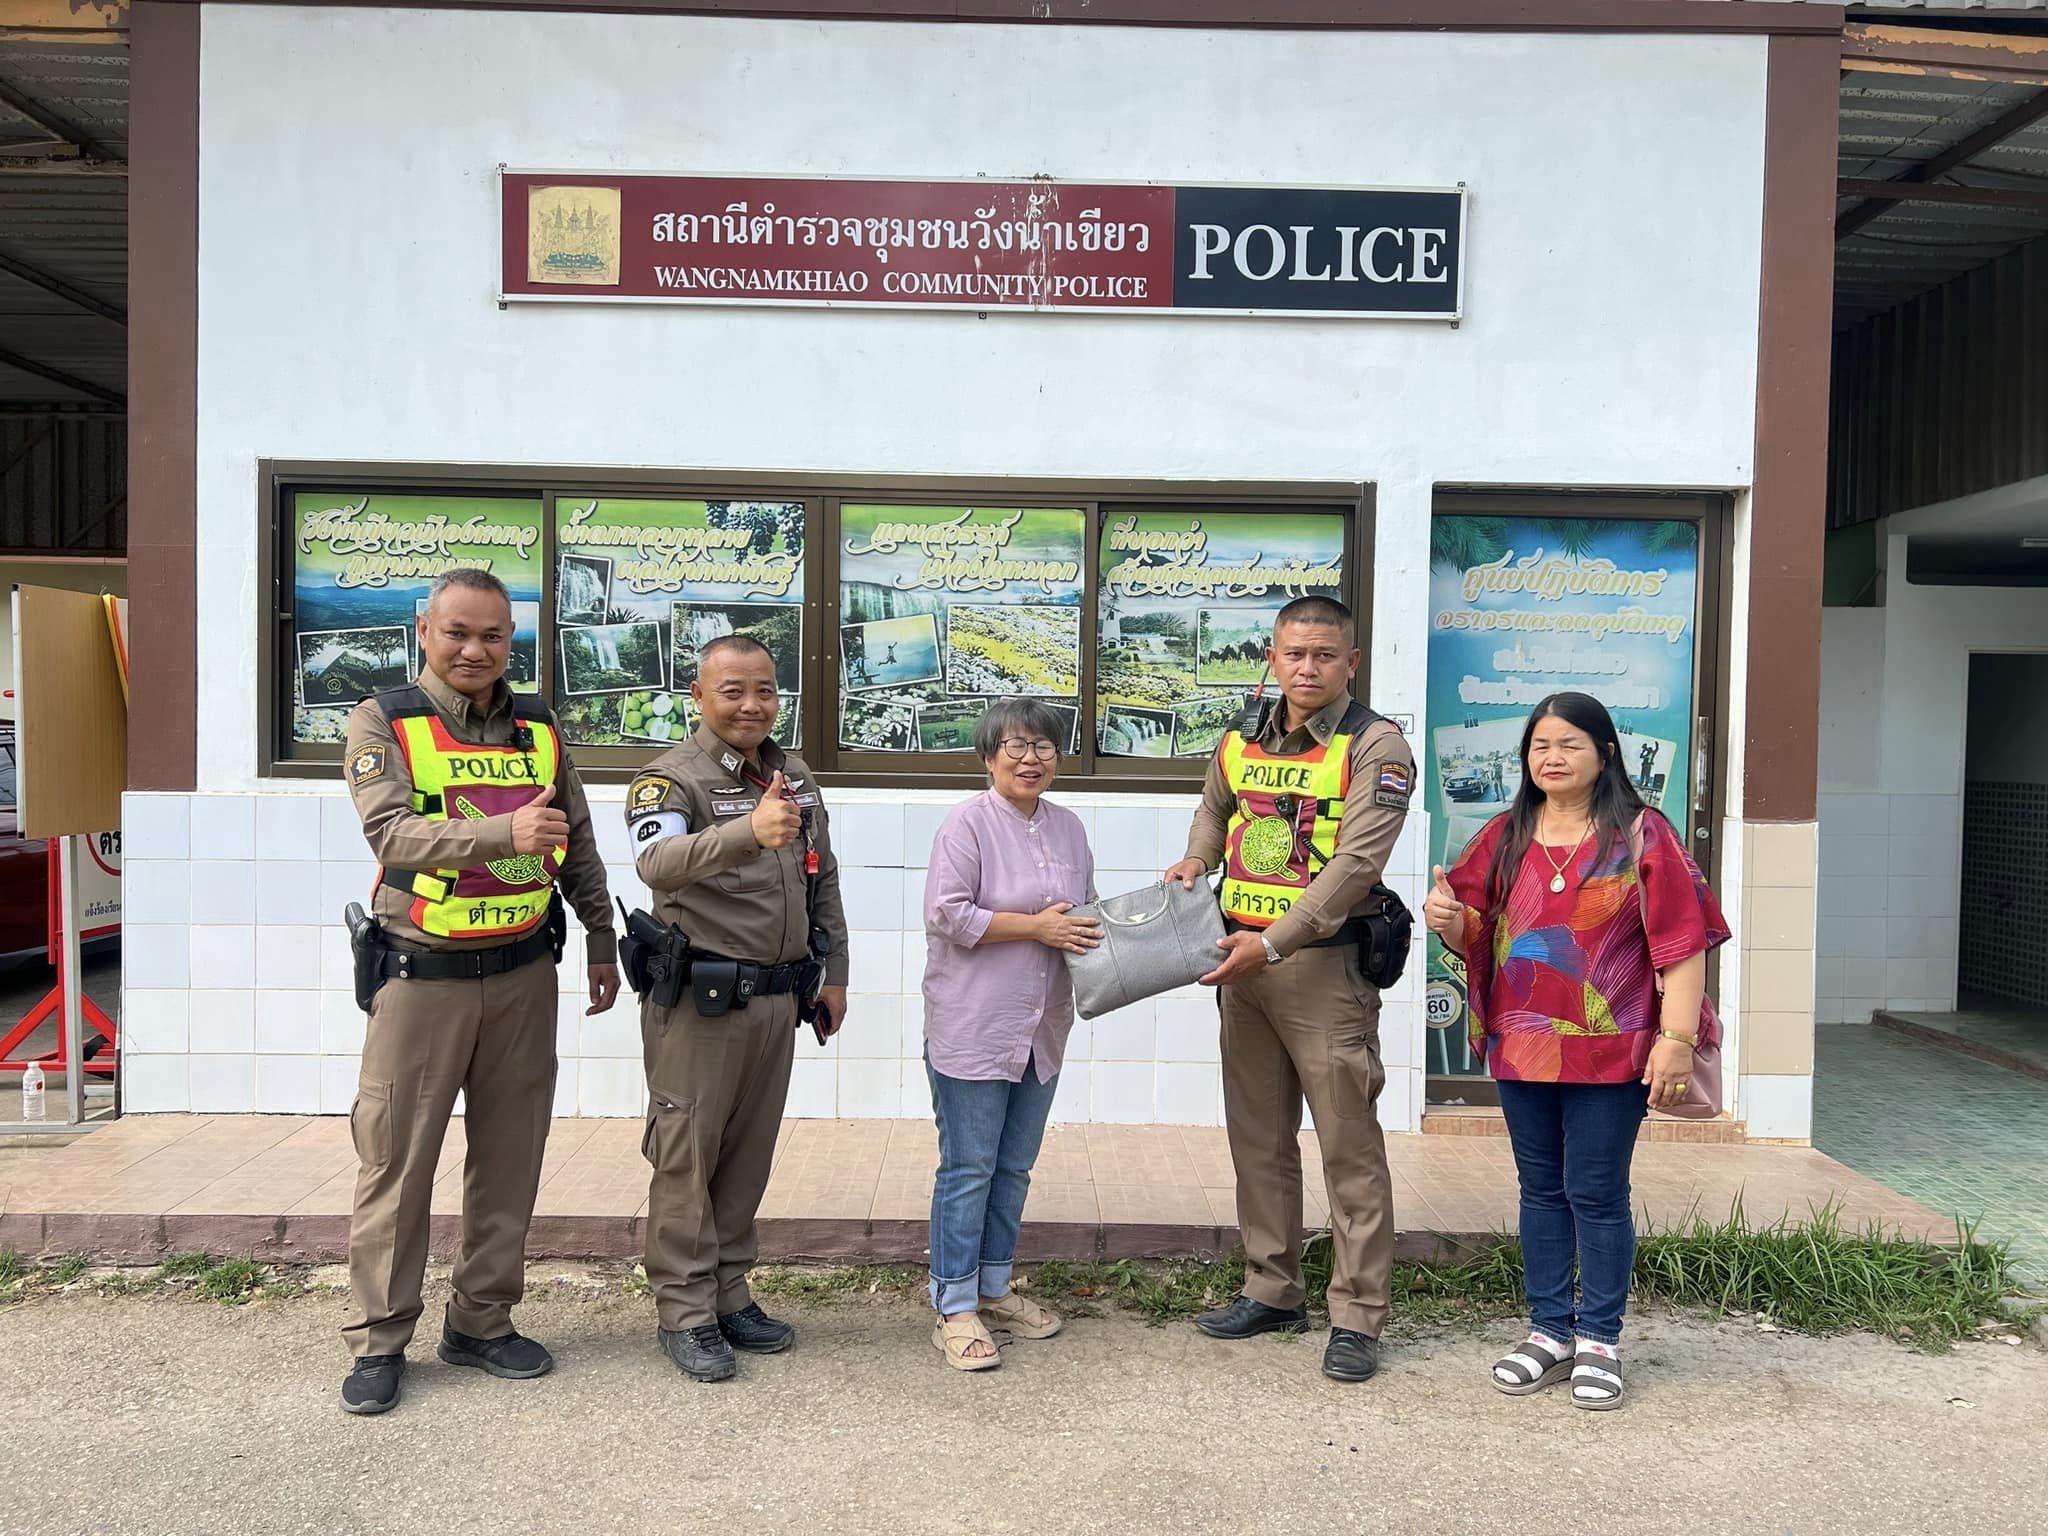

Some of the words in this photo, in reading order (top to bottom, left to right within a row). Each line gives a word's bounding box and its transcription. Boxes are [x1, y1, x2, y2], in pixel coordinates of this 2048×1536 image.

[652, 195, 1150, 263] สถานีตำรวจชุมชนวังน้ำเขียว
[1188, 223, 1448, 283] POLICE
[653, 266, 869, 293] WANGNAMKHIAO
[883, 271, 1045, 297] COMMUNITY
[1054, 275, 1148, 299] POLICE
[1464, 548, 1667, 603] ศูนย์ปฏิบัติการ
[1436, 607, 1686, 643] จราจรและลดอุบัติเหตุ
[448, 757, 539, 780] POLICE
[1241, 764, 1313, 789] POLICE
[631, 804, 660, 817] POLICE
[1231, 884, 1292, 915] ตำรวจ
[1427, 999, 1450, 1014] 60
